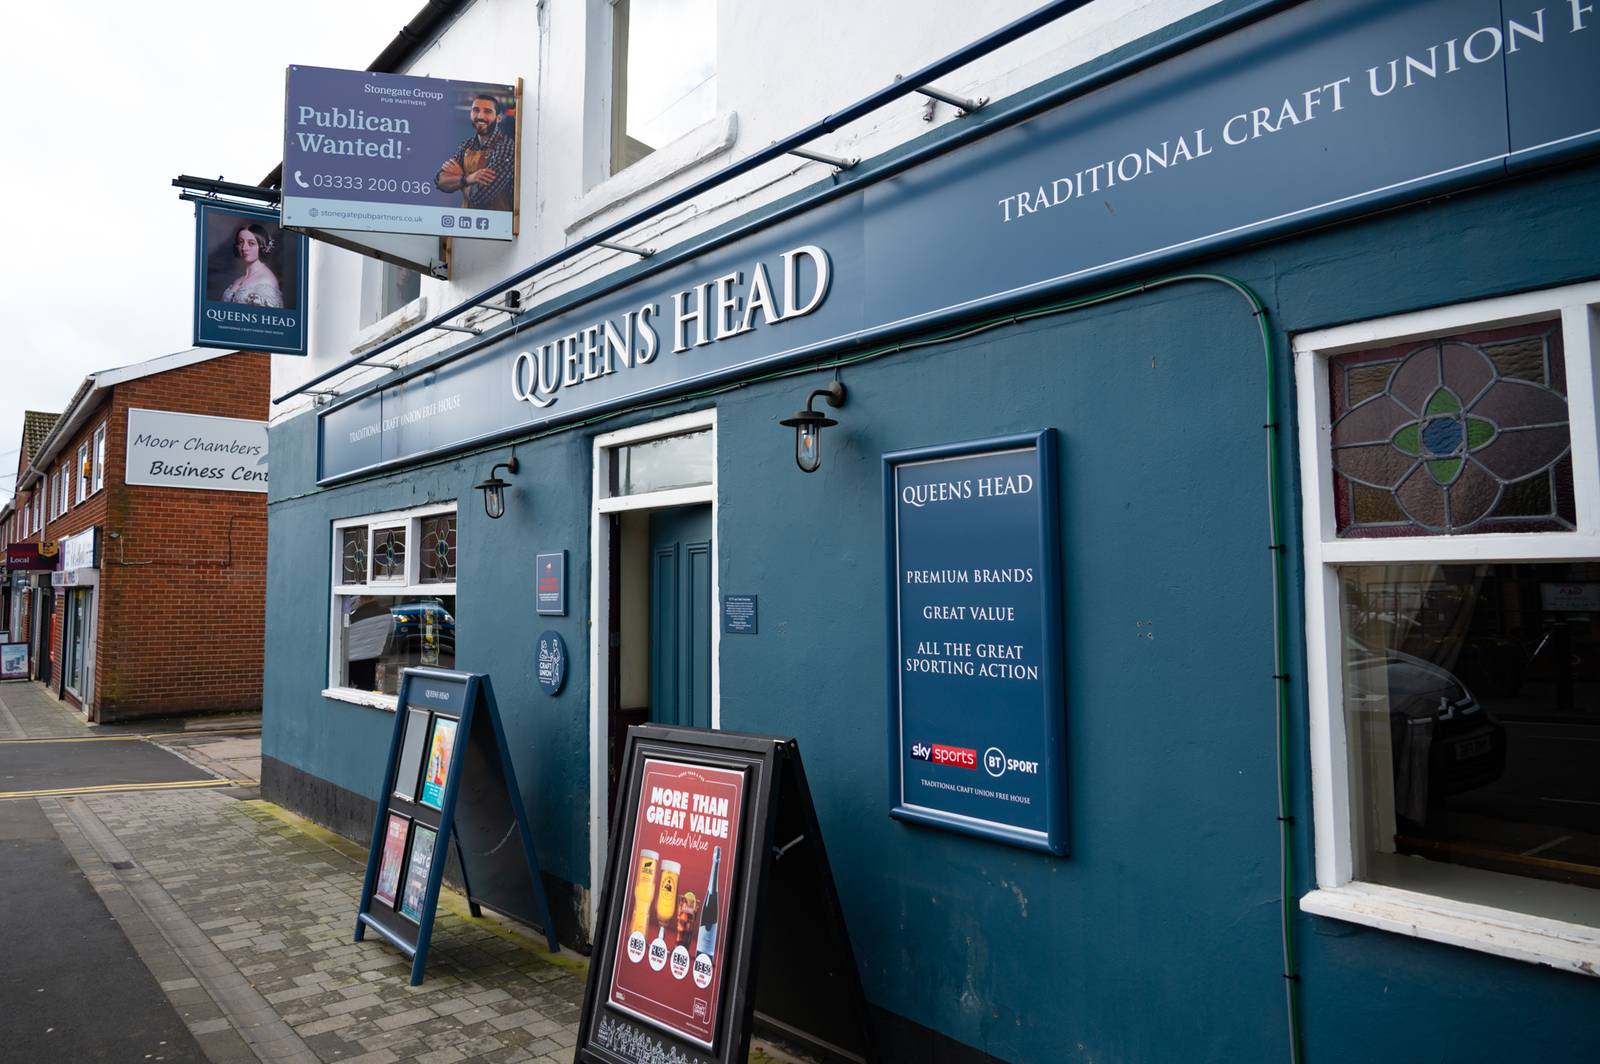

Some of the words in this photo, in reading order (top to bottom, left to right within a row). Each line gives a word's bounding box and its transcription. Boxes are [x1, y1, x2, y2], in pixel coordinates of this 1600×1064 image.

[364, 84, 412, 97] Stonegate
[413, 88, 444, 101] Group
[297, 105, 411, 134] Publican
[998, 128, 1213, 223] TRADITIONAL
[1222, 76, 1351, 146] CRAFT
[1366, 8, 1546, 97] UNION
[296, 132, 402, 159] Wanted!
[313, 174, 363, 190] 03333
[368, 178, 397, 192] 200
[401, 180, 431, 195] 036
[321, 209, 423, 223] stonegatepubpartners.co.uk
[206, 309, 257, 323] QUEENS
[262, 315, 296, 328] HEAD
[511, 303, 660, 408] QUEENS
[671, 245, 831, 354] HEAD
[382, 415, 400, 431] CRAFT
[401, 407, 421, 425] UNION
[438, 393, 461, 413] HOUSE
[134, 434, 179, 448] Moor
[183, 437, 262, 456] Chambers
[149, 460, 225, 479] Business
[903, 480, 972, 507] QUEENS
[978, 474, 1033, 497] HEAD
[907, 570, 969, 584] PREMIUM
[974, 568, 1033, 583] BRANDS
[923, 606, 966, 620] GREAT
[970, 606, 1015, 621] VALUE
[917, 642, 940, 655] ALL
[943, 642, 972, 657] THE
[976, 644, 1023, 660] GREAT
[906, 658, 974, 676] SPORTING
[979, 663, 1038, 680] ACTION
[912, 743, 931, 760] sky
[934, 748, 974, 765] sports
[989, 756, 1001, 768] BT
[1007, 759, 1038, 774] SPORT
[651, 787, 690, 811] MORE
[692, 794, 729, 817] THAN
[921, 779, 956, 791] TRADITIONAL
[956, 785, 974, 794] CRAFT
[974, 788, 995, 798] UNION
[995, 792, 1009, 801] FREE
[1010, 794, 1031, 805] HOUSE
[646, 806, 686, 830] GREAT
[689, 814, 729, 839] VALUE
[659, 831, 689, 847] Weekend
[688, 833, 709, 851] Value
